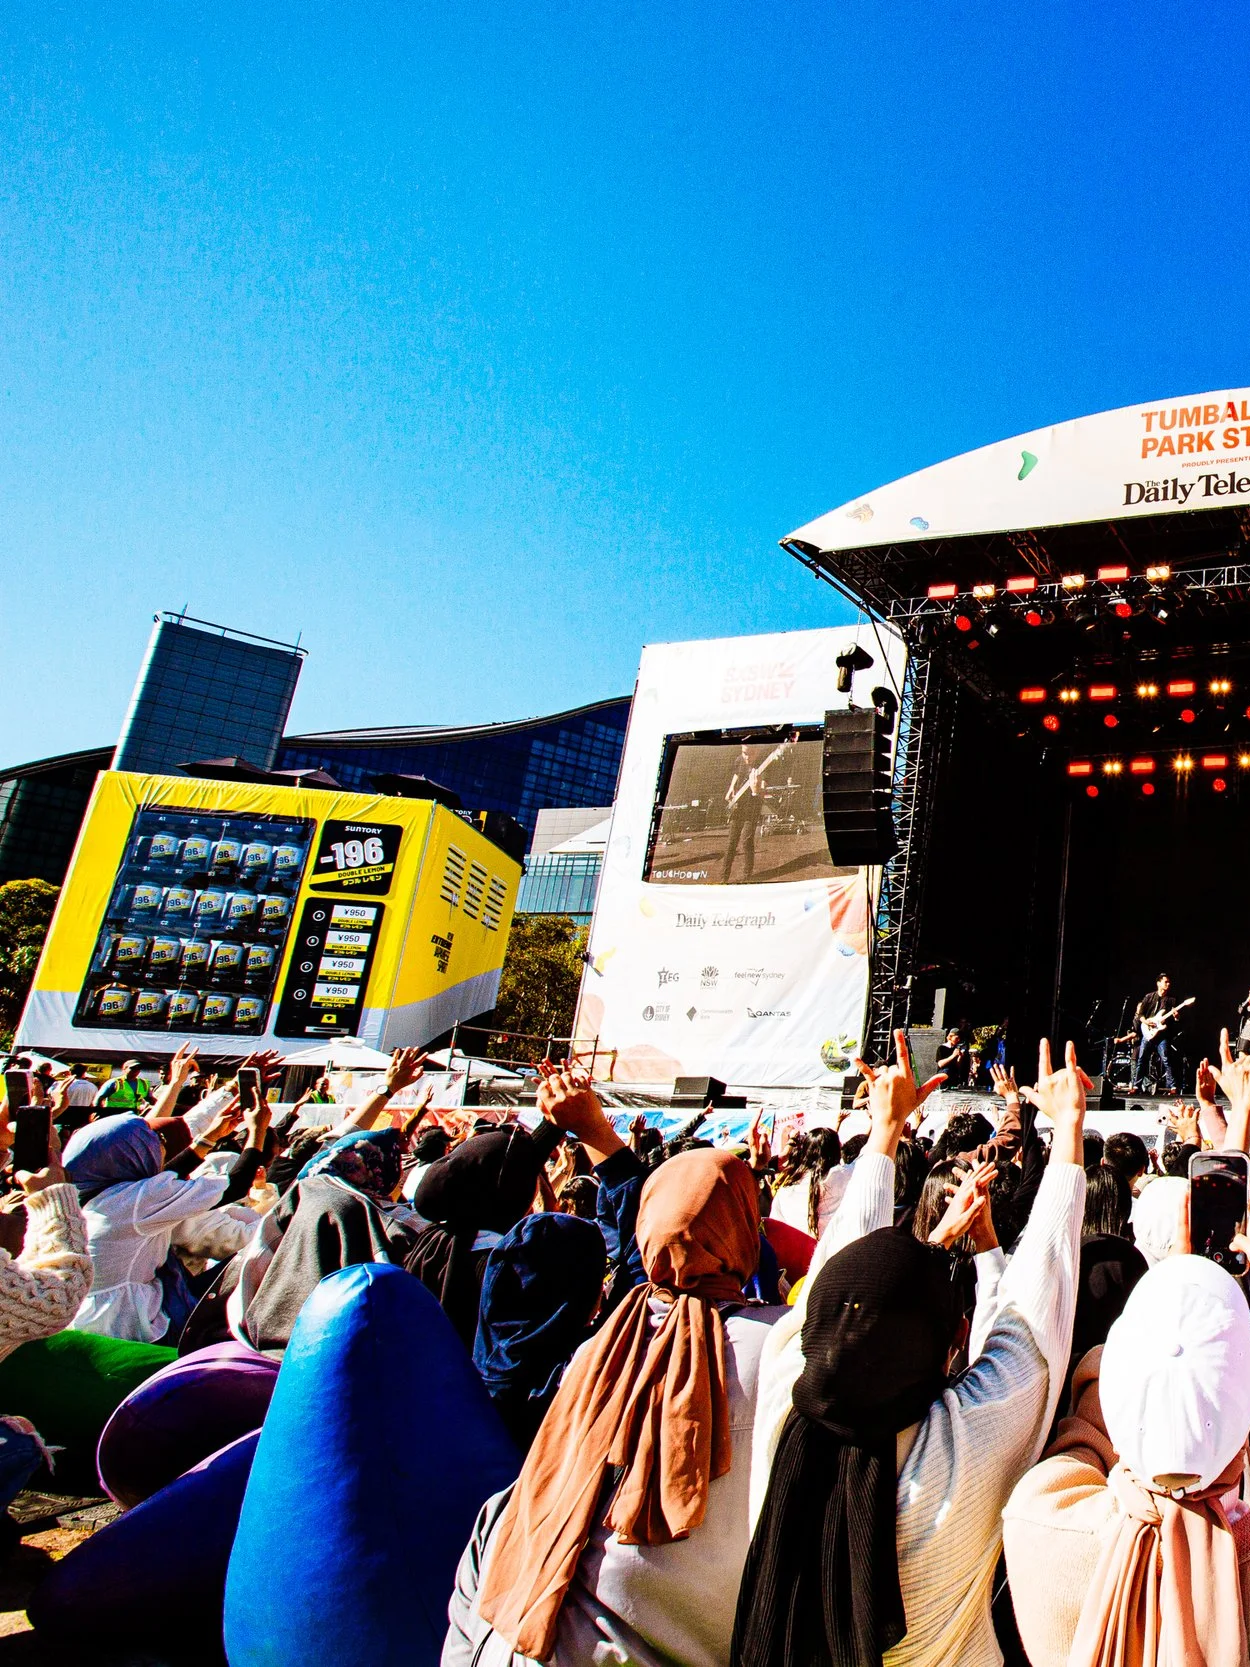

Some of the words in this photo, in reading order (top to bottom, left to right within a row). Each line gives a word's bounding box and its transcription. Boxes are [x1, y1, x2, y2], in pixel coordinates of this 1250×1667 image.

[1141, 430, 1215, 459] PARK
[1181, 460, 1214, 468] PROUDLY
[1145, 480, 1161, 488] The
[1122, 476, 1196, 506] Daily
[721, 680, 796, 703] SYDNEY
[344, 825, 383, 834] SUNTORY
[320, 837, 384, 869] -196
[338, 869, 362, 878] DOUBLE
[363, 866, 385, 875] LEMON
[652, 870, 708, 880] TOUCHDOWN
[344, 909, 366, 917] ¥950
[676, 913, 707, 929] Daily
[711, 911, 776, 929] Telegraph
[338, 934, 360, 942] ¥950
[332, 960, 354, 968] ¥950
[700, 979, 718, 987] NSW
[326, 987, 348, 995] ¥950
